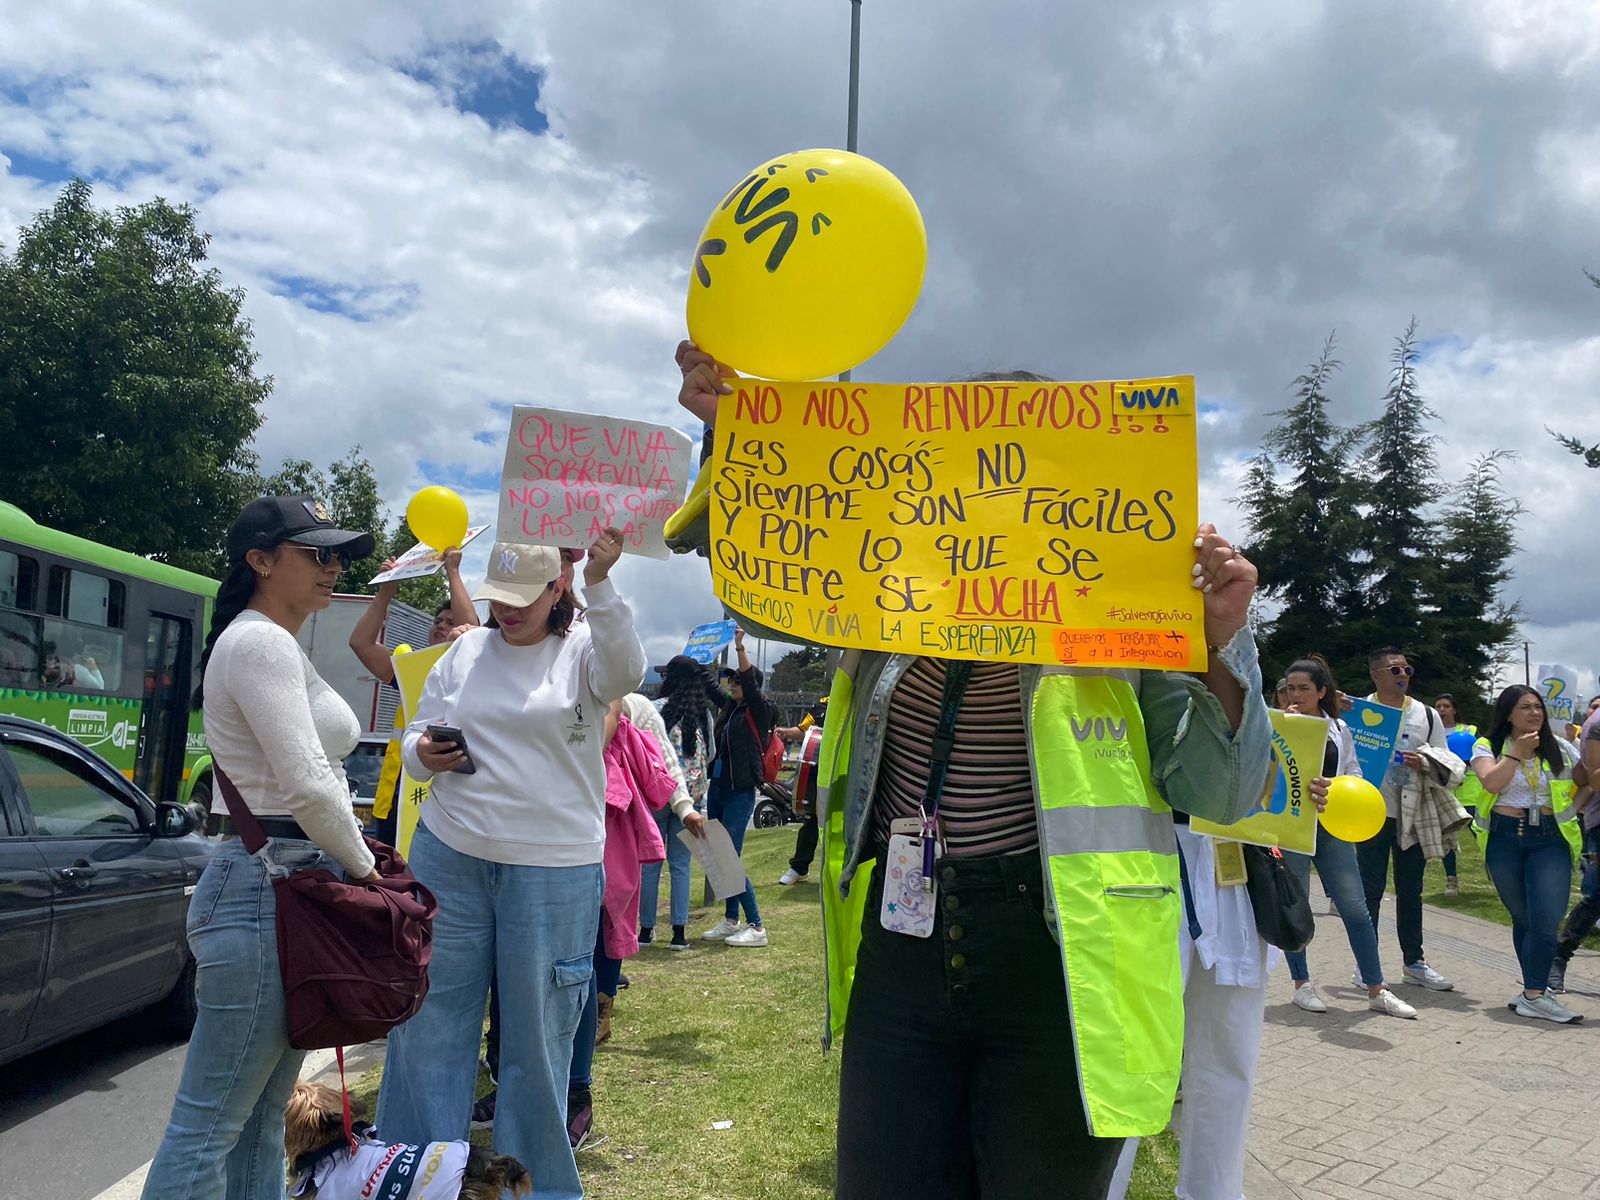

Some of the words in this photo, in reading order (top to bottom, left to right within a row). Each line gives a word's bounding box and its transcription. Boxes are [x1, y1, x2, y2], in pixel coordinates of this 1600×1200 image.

[735, 385, 783, 425] NO
[802, 387, 870, 436] NOS
[1120, 386, 1180, 410] VIVA
[518, 415, 596, 458] QUE
[603, 426, 677, 464] VIVA
[523, 454, 677, 495] SOBREVIVA
[976, 442, 1026, 490] NO
[508, 486, 549, 509] NO
[564, 489, 616, 519] NOS
[719, 499, 742, 536] Y
[888, 487, 967, 526] SON
[521, 508, 574, 540] LAS
[875, 574, 933, 613] SE
[955, 575, 1063, 623] LUCHA
[880, 619, 903, 642] LA
[920, 621, 1037, 656] ESPERANZA
[70, 722, 104, 735] LIMPIA
[1071, 716, 1127, 742] VIV
